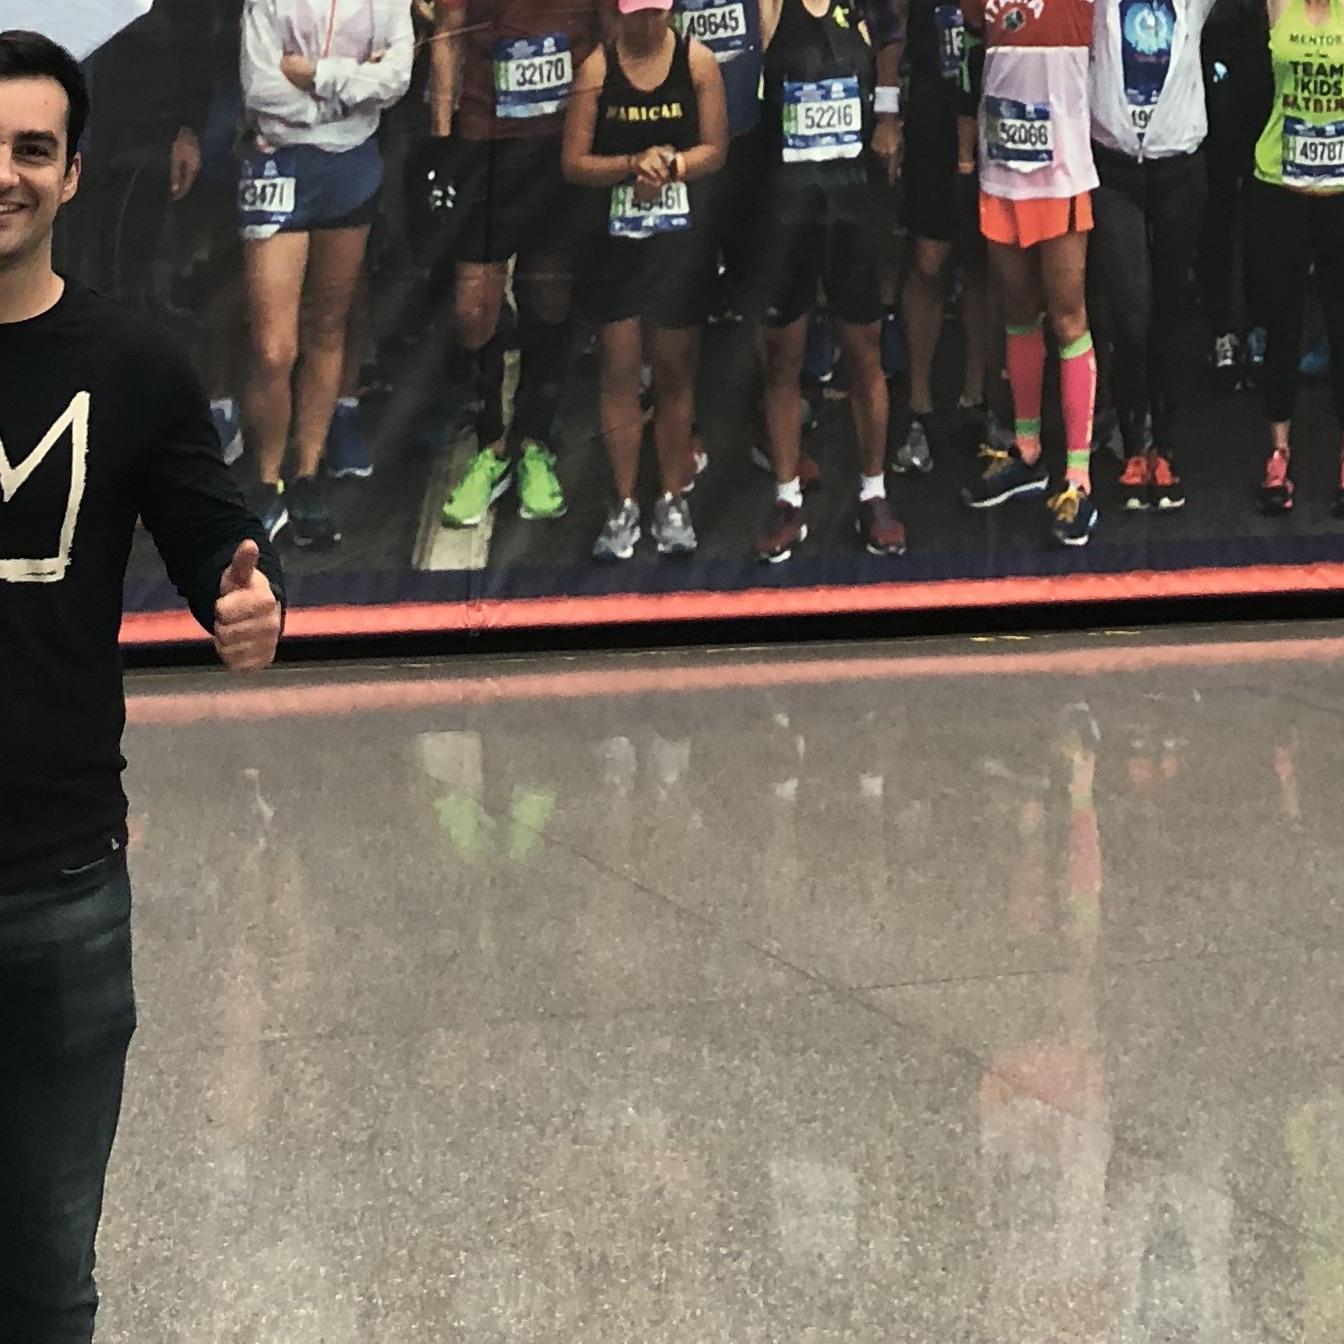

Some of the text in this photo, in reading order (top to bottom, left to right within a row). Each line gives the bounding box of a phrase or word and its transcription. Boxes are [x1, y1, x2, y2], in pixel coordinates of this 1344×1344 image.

[687, 9, 740, 37] 49645
[1289, 32, 1344, 47] MENTOR
[515, 57, 566, 87] 32170
[1289, 60, 1344, 79] TEAM
[804, 104, 853, 130] 52216
